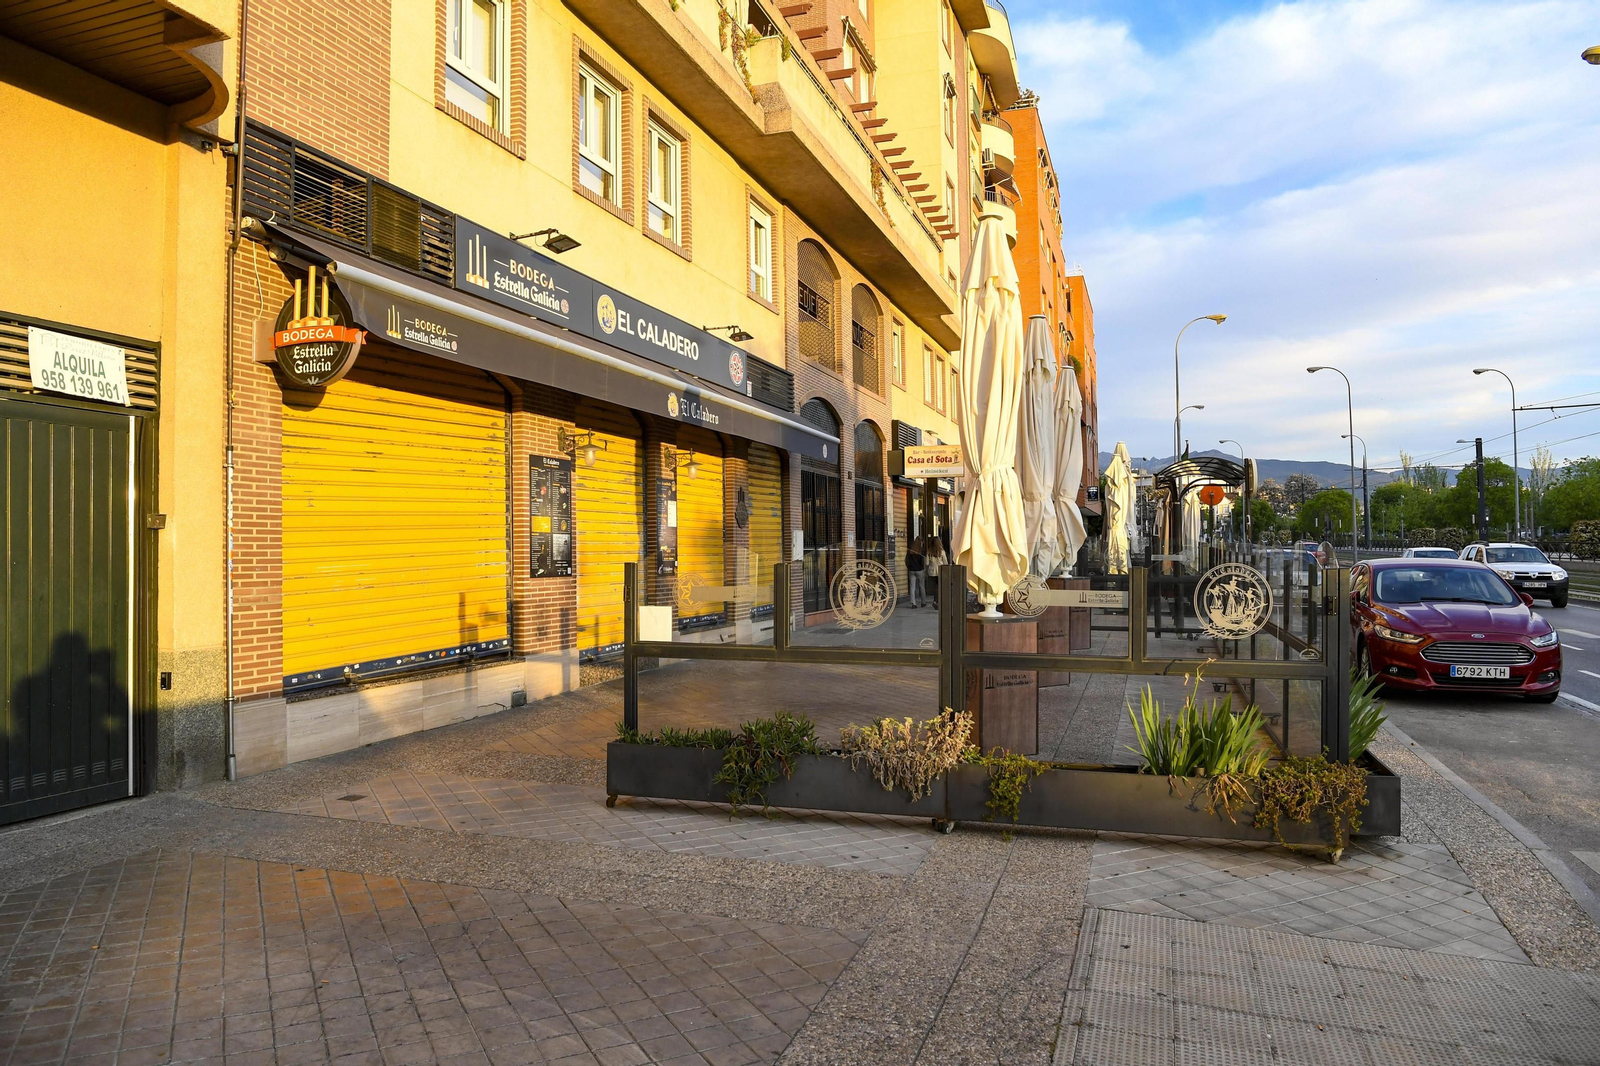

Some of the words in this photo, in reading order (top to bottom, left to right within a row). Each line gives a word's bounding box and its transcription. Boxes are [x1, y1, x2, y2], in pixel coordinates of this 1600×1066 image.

[509, 259, 555, 291] BODEGA
[494, 271, 530, 300] Estrella
[530, 286, 560, 312] Galicia
[282, 328, 334, 343] BODEGA
[404, 327, 429, 344] Estrella
[429, 334, 451, 350] Galicia
[414, 318, 448, 337] BODEGA
[617, 309, 635, 336] EL
[637, 318, 699, 361] CALADERO
[293, 344, 334, 359] Estrella
[53, 351, 106, 379] ALQUILA
[294, 359, 332, 374] Galicia
[41, 368, 66, 390] 958
[70, 375, 93, 395] 139
[97, 380, 120, 401] 961
[680, 397, 690, 417] El
[690, 402, 719, 425] Caladero
[907, 455, 925, 464] Casa
[926, 455, 934, 464] el
[934, 455, 953, 464] Sota
[1456, 667, 1482, 676] 6792
[1486, 668, 1506, 677] KTH
